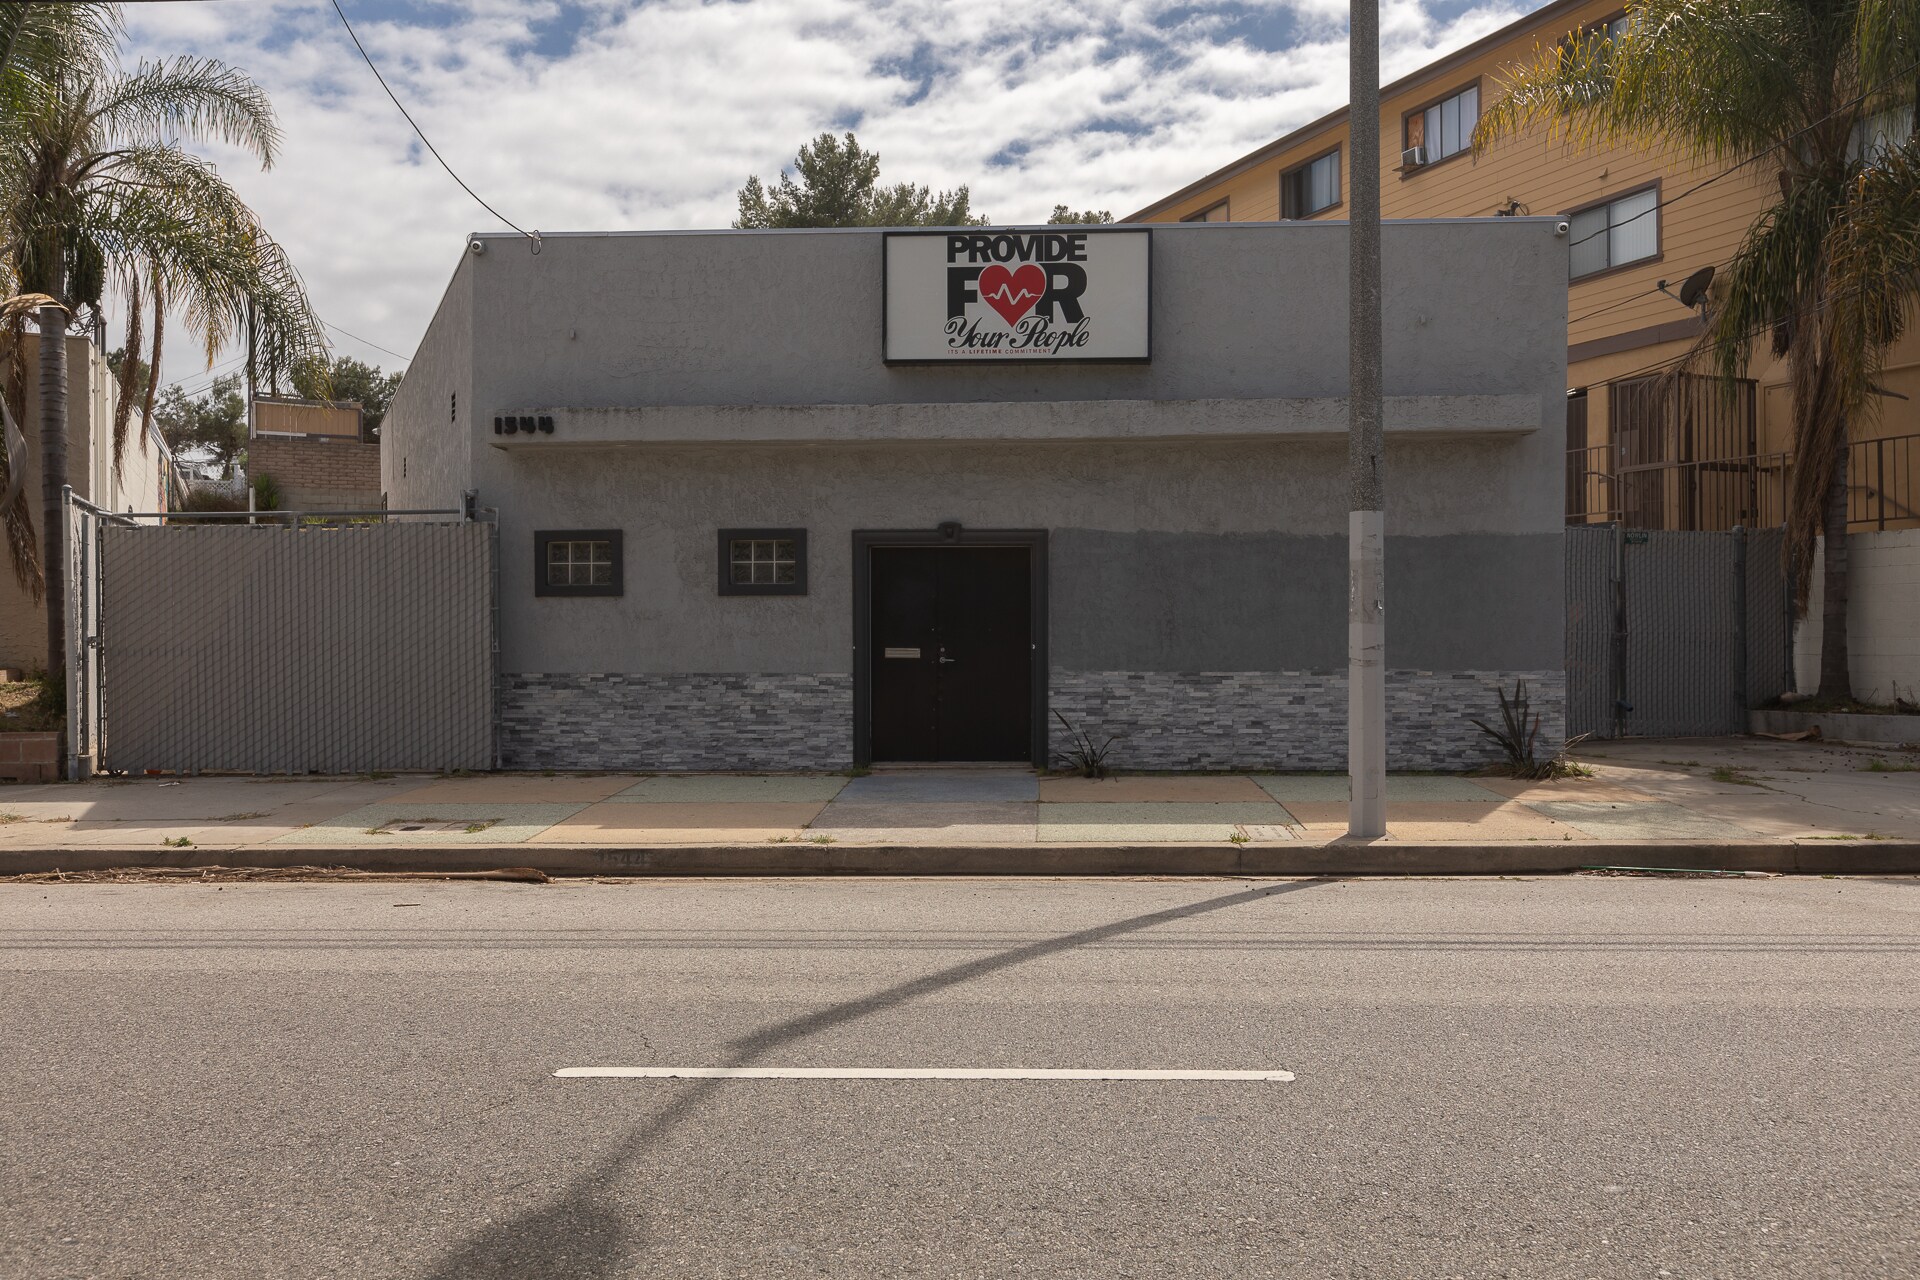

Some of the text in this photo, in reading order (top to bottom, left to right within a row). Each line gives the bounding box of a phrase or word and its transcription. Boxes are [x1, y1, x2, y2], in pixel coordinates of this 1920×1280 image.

[947, 234, 1087, 263] PROVIDE
[947, 263, 1088, 324] FR
[944, 315, 1091, 355] Your People
[1004, 347, 1052, 355] COMMITMENT
[494, 416, 555, 435] 1544
